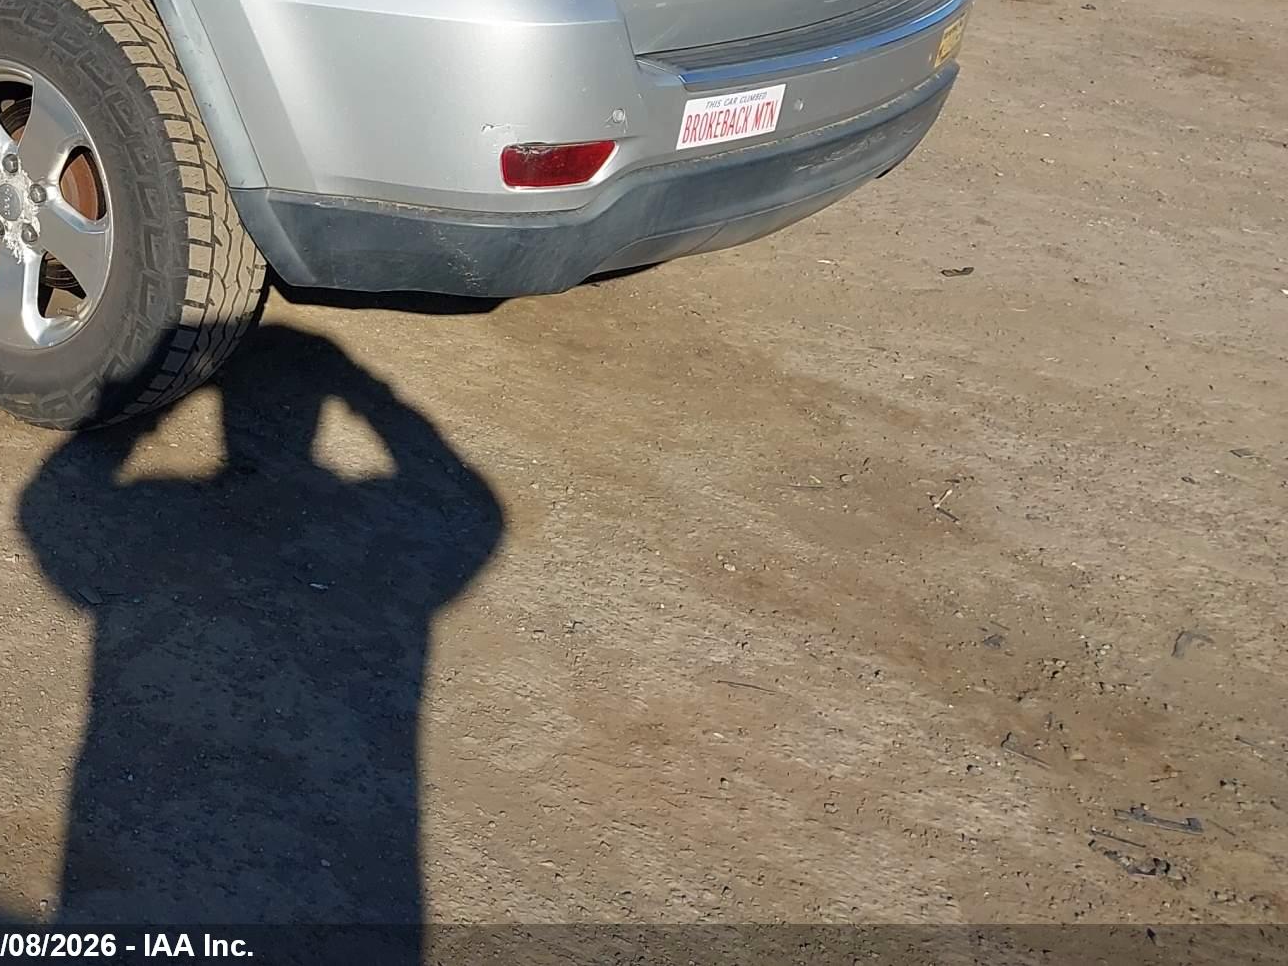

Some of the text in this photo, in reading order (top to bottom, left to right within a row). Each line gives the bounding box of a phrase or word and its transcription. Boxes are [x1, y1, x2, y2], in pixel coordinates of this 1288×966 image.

[705, 91, 768, 110] THIS CAR CLIMBED
[682, 104, 752, 144] BROKEBACK
